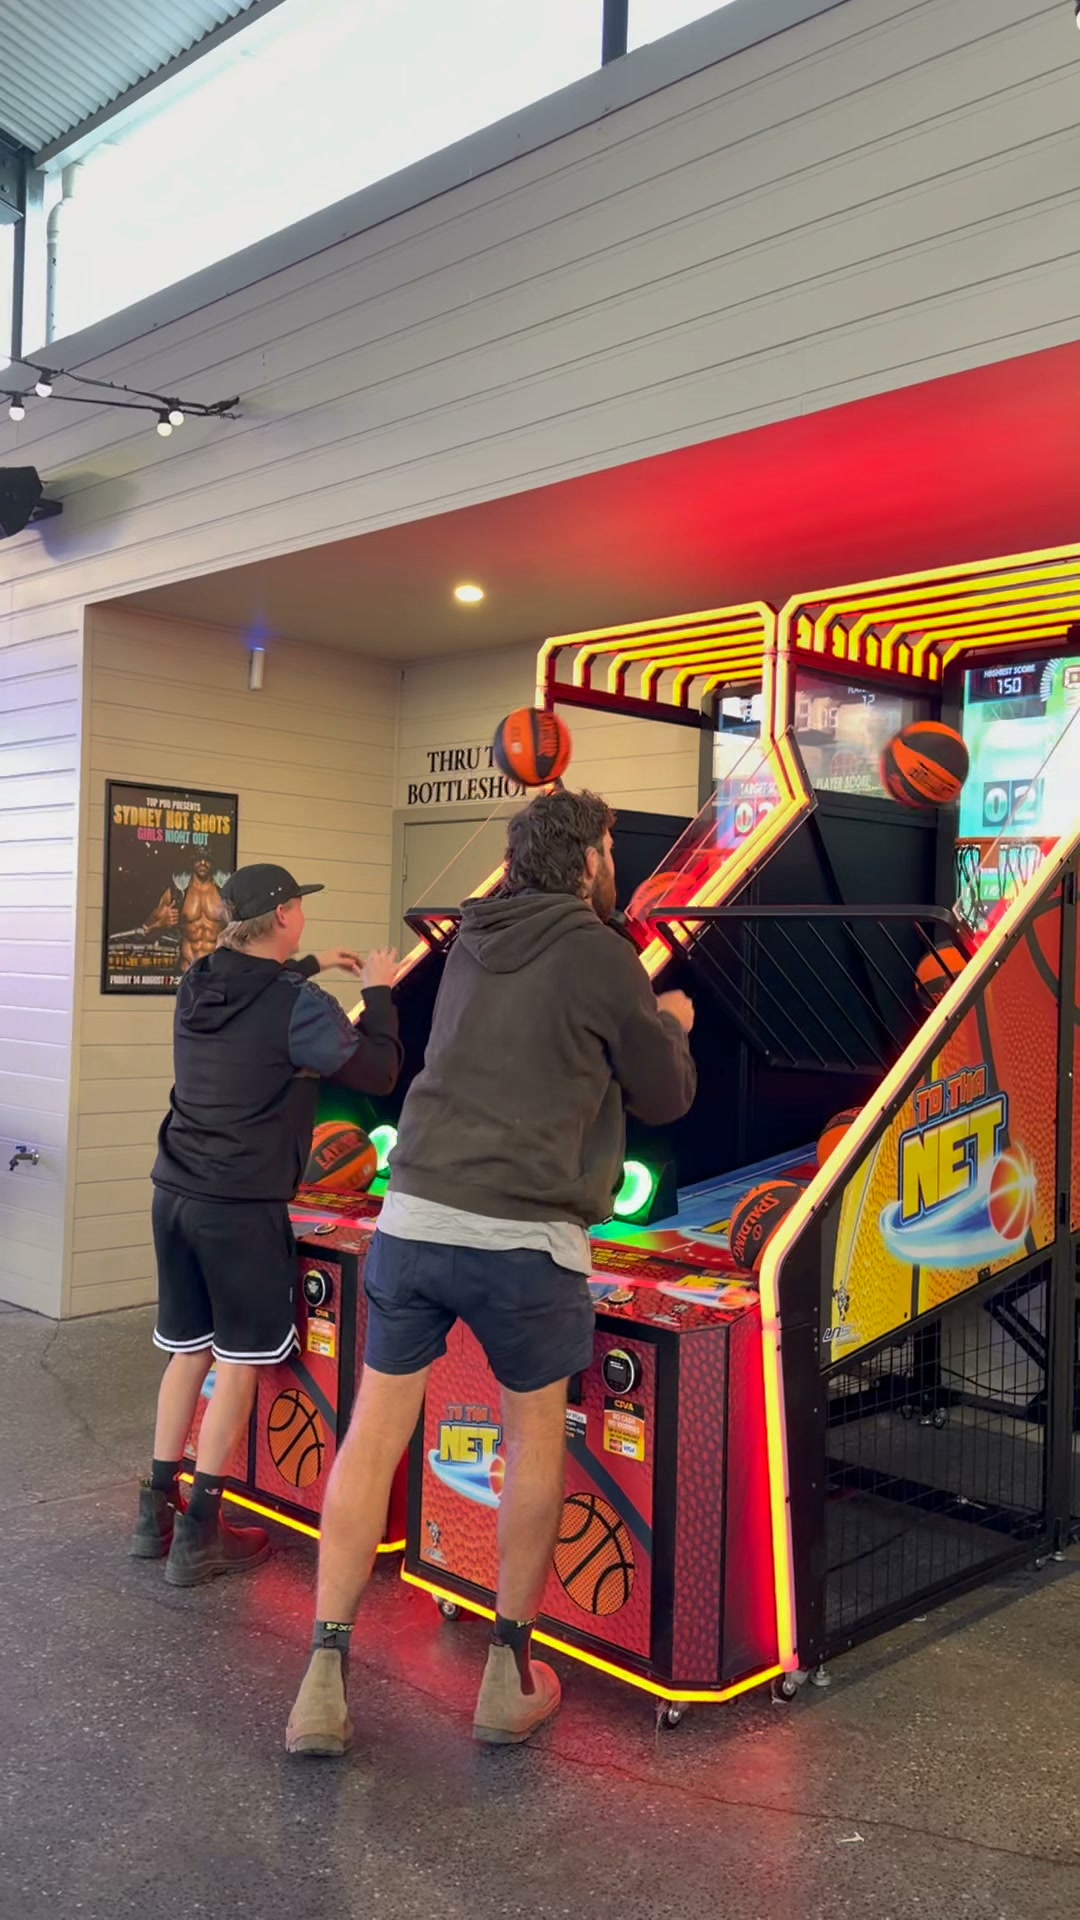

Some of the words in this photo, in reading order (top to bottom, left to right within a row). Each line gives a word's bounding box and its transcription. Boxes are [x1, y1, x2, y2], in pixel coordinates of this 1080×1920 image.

[984, 667, 1012, 678] HIGHEST
[1014, 664, 1036, 674] SCORE
[997, 677, 1022, 694] 150
[427, 747, 480, 773] THRU
[147, 797, 158, 807] TOP
[159, 799, 171, 809] PUB
[172, 800, 201, 812] PRESENTS
[984, 785, 1037, 823] 02
[113, 804, 162, 828] SYDNEY
[166, 809, 190, 830] HOT
[192, 813, 231, 835] SHOTS
[137, 827, 163, 841] GIRLS
[165, 829, 190, 844] NIGHT
[192, 832, 209, 846] OUT
[110, 975, 132, 985] FRIDAY
[141, 975, 164, 985] AUGUST
[916, 1084, 943, 1124] TO
[948, 1067, 985, 1111] THA
[901, 1100, 1003, 1223] NET
[733, 1192, 780, 1262] SPALDING
[440, 1424, 499, 1463] NET
